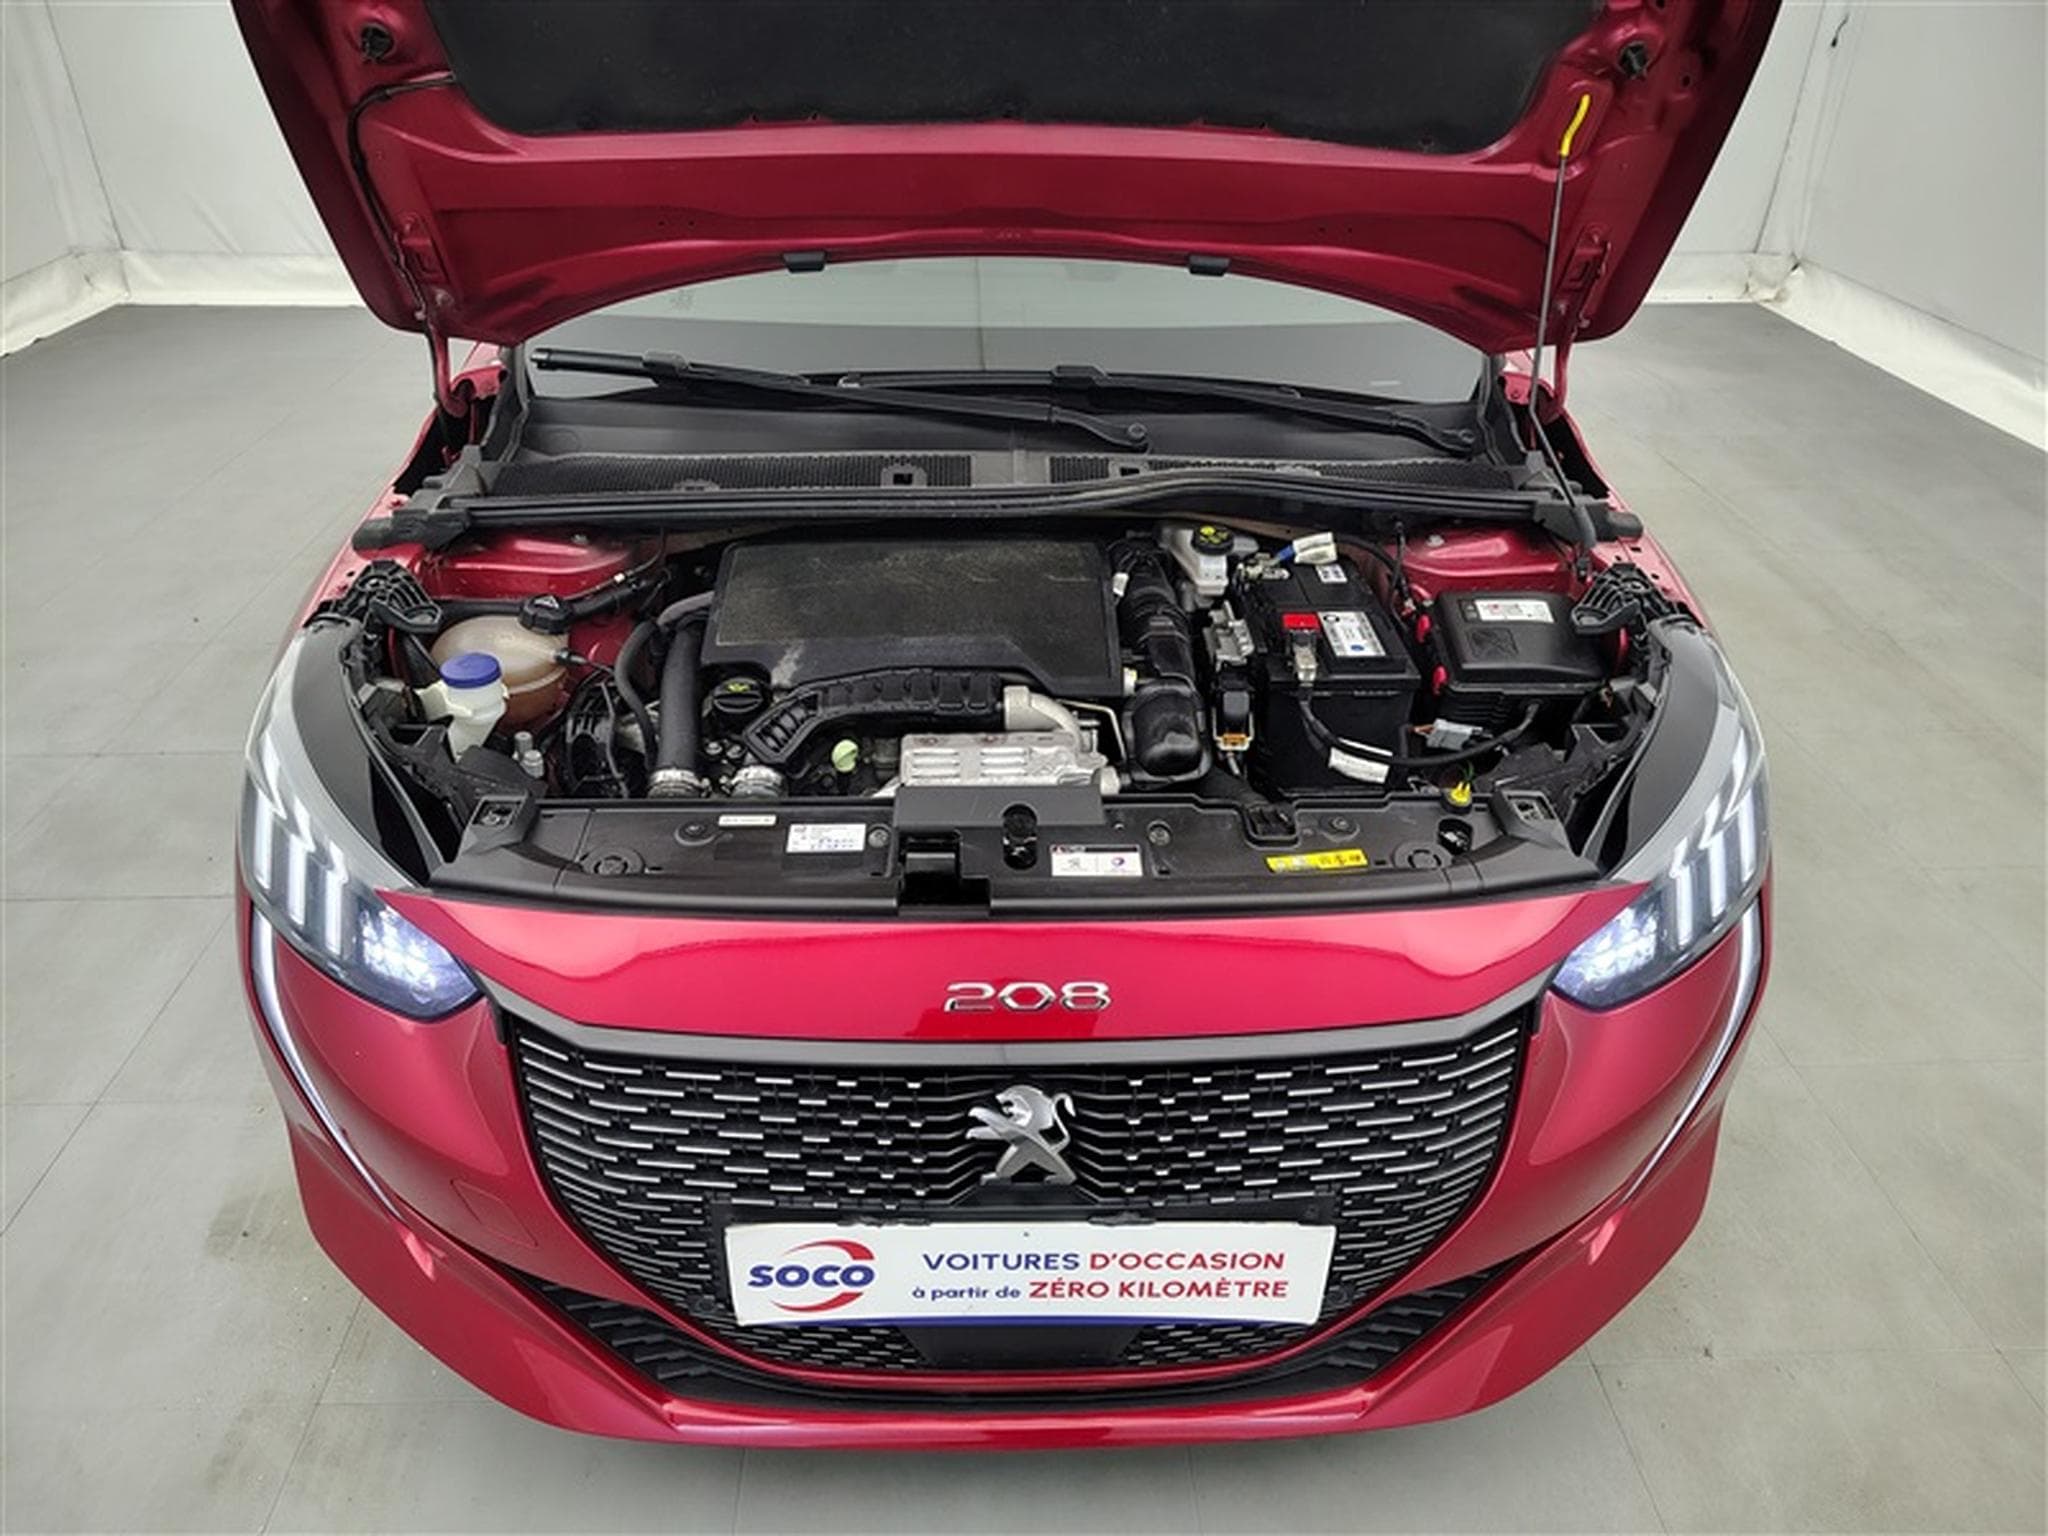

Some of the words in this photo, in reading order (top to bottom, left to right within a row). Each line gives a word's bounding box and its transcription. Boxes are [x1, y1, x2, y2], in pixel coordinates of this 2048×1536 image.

[944, 981, 1111, 1012] 208
[922, 1253, 1080, 1271] VOITURES
[1089, 1252, 1285, 1271] D'OCCASION
[748, 1264, 875, 1288] SOCO
[912, 1285, 926, 1299] à
[931, 1285, 989, 1302] partir
[995, 1285, 1022, 1299] de
[1028, 1277, 1110, 1299] ZÉRO
[1118, 1277, 1289, 1299] KILOMÈTRE
